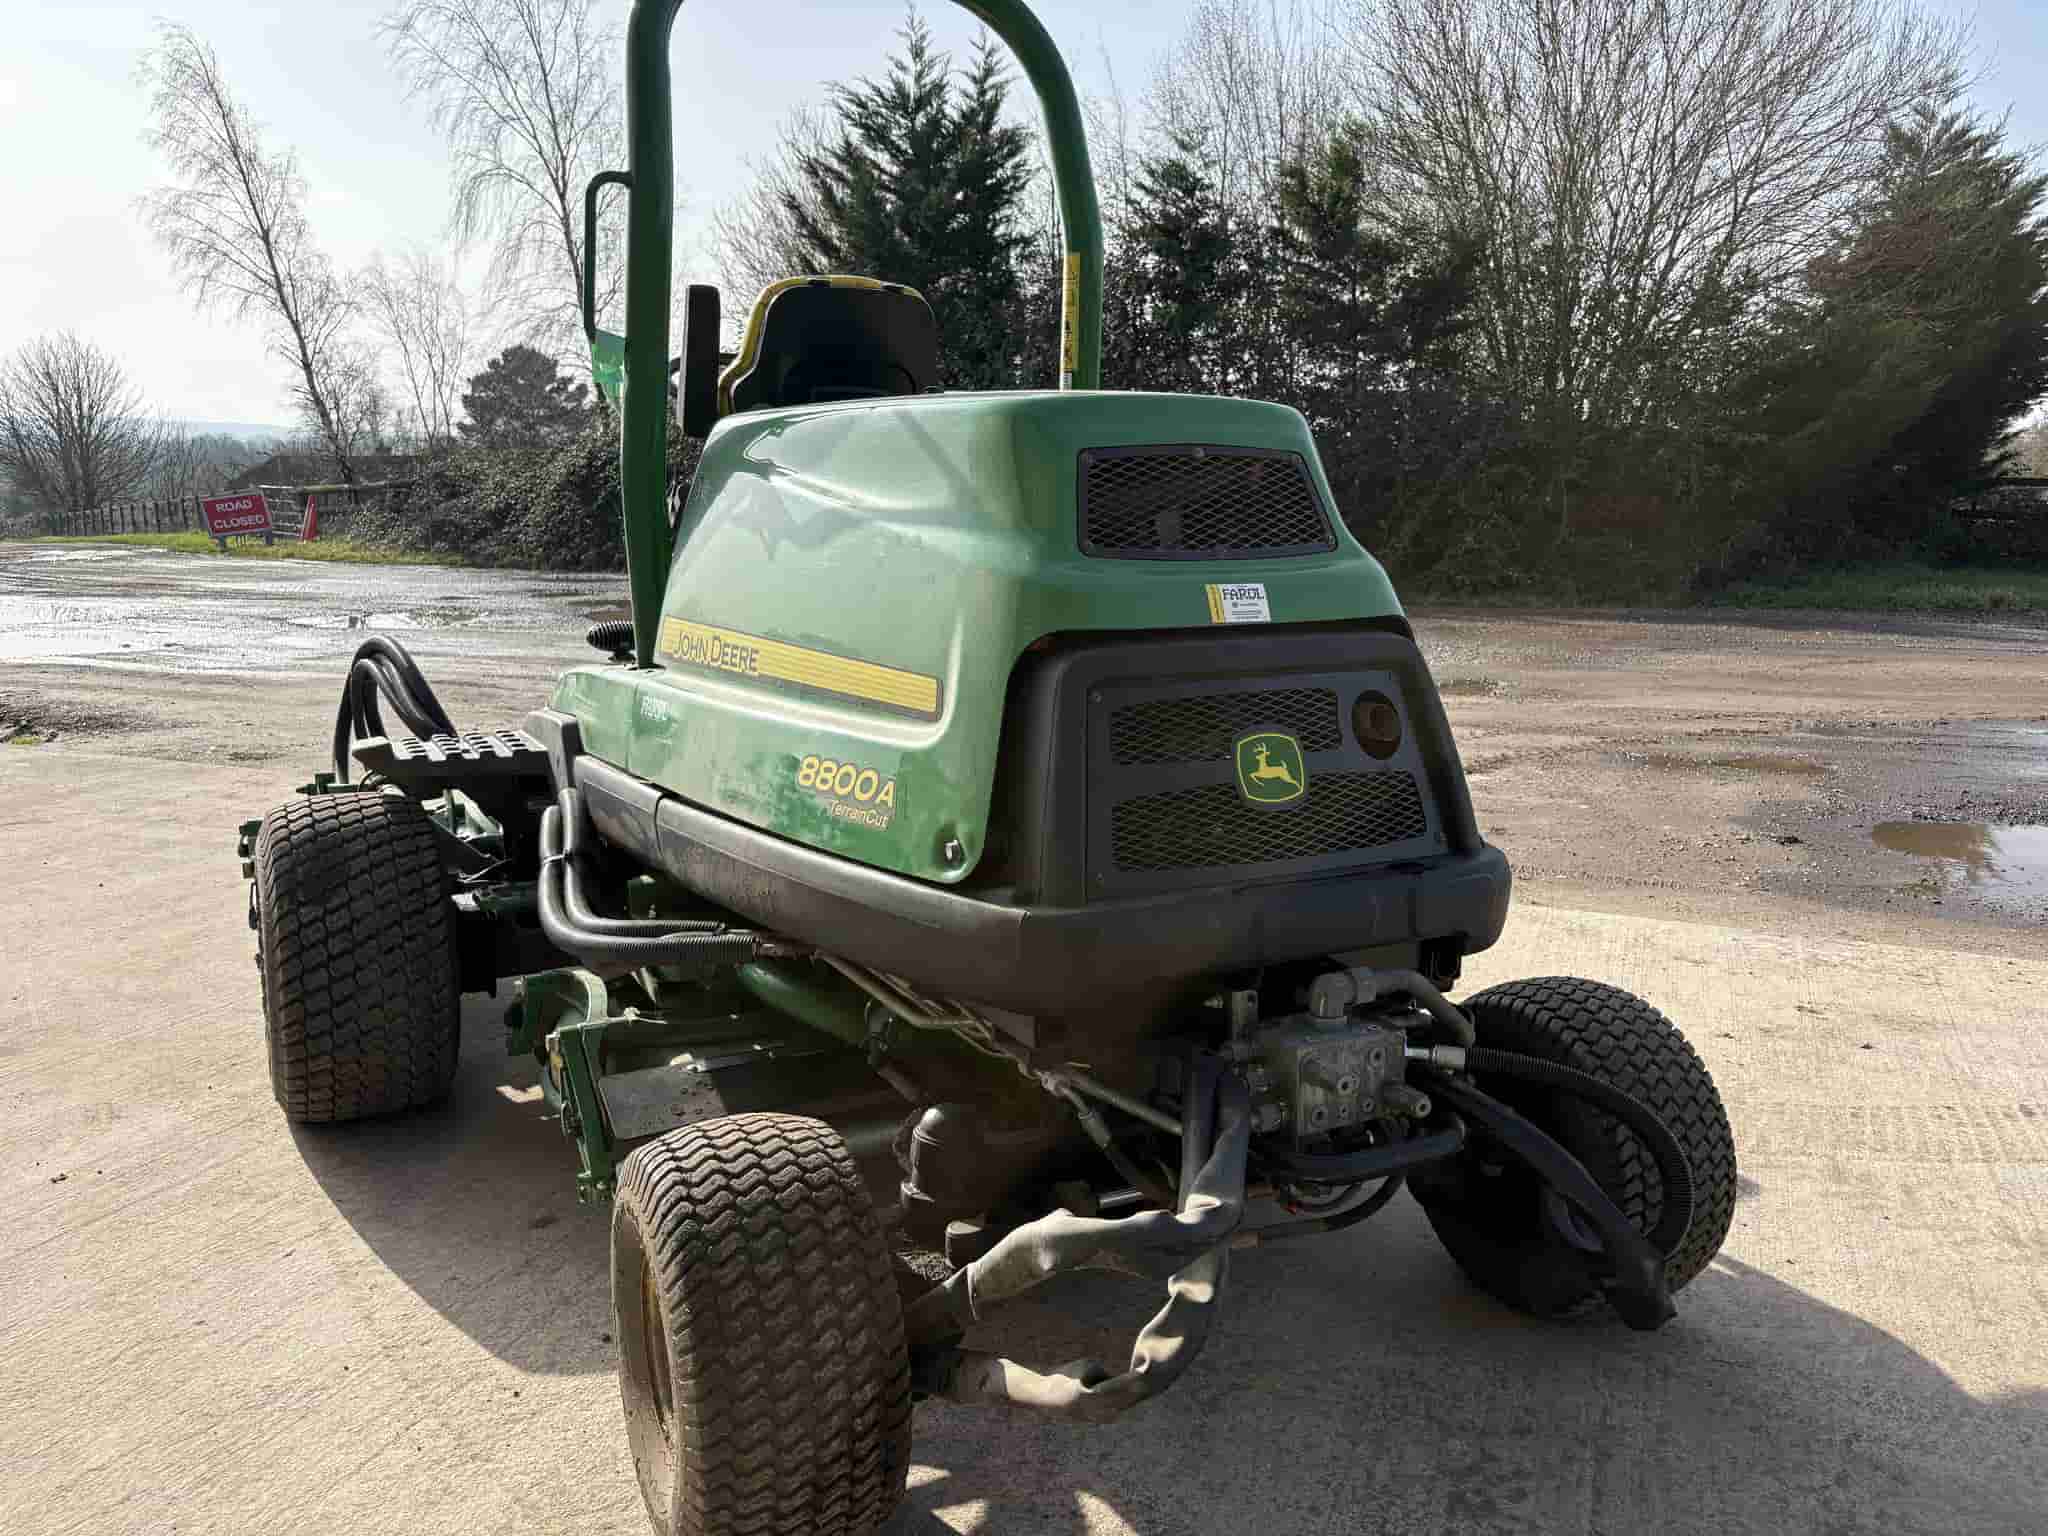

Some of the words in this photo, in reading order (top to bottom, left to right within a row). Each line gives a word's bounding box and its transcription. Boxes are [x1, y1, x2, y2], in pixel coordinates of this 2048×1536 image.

[216, 500, 253, 513] ROAD
[215, 515, 264, 529] CLOSED
[673, 631, 709, 664] JOHN
[711, 635, 759, 671] DEERE
[798, 754, 896, 808] 8800A
